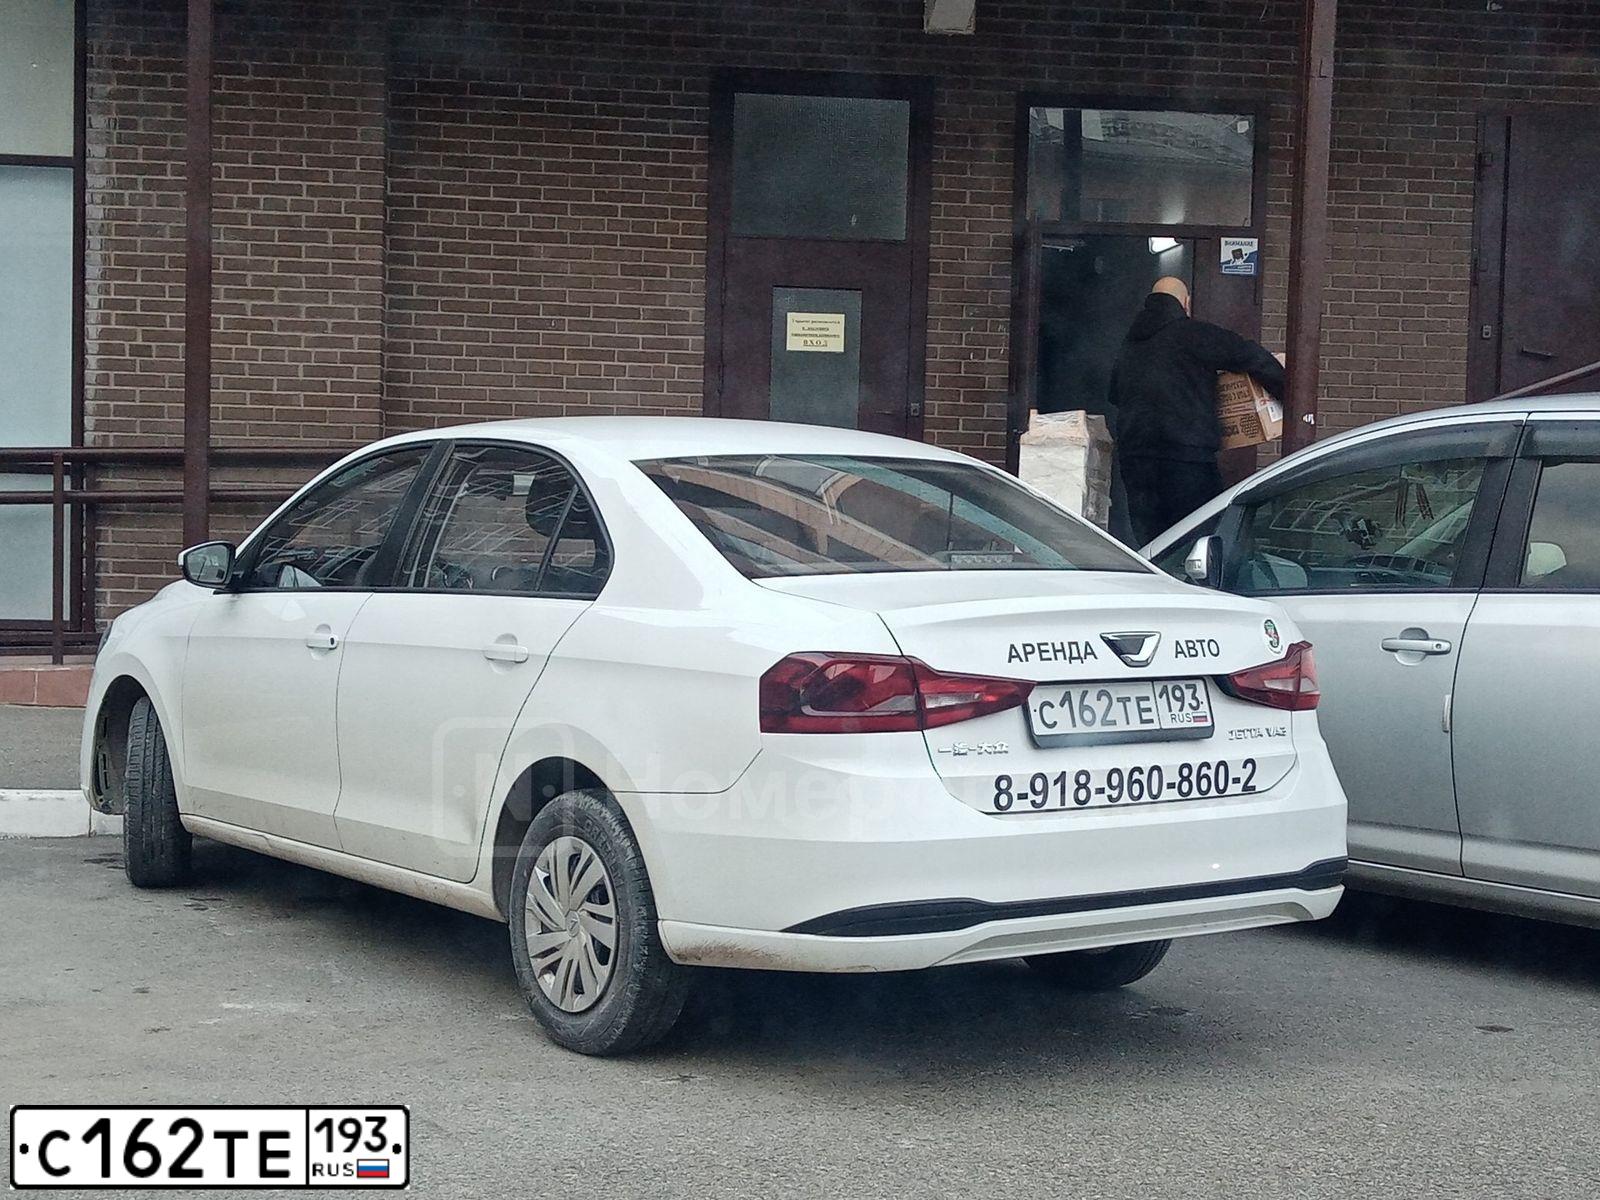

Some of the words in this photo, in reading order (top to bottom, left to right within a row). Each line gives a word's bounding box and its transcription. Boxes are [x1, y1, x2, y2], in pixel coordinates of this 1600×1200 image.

[1007, 641, 1098, 663] АРЕНДА
[1174, 638, 1221, 659] АВТО
[1158, 683, 1201, 713] 193
[1170, 712, 1193, 724] RUS
[1228, 728, 1264, 741] JETTA
[993, 758, 1257, 811] 8-918-960-860-2
